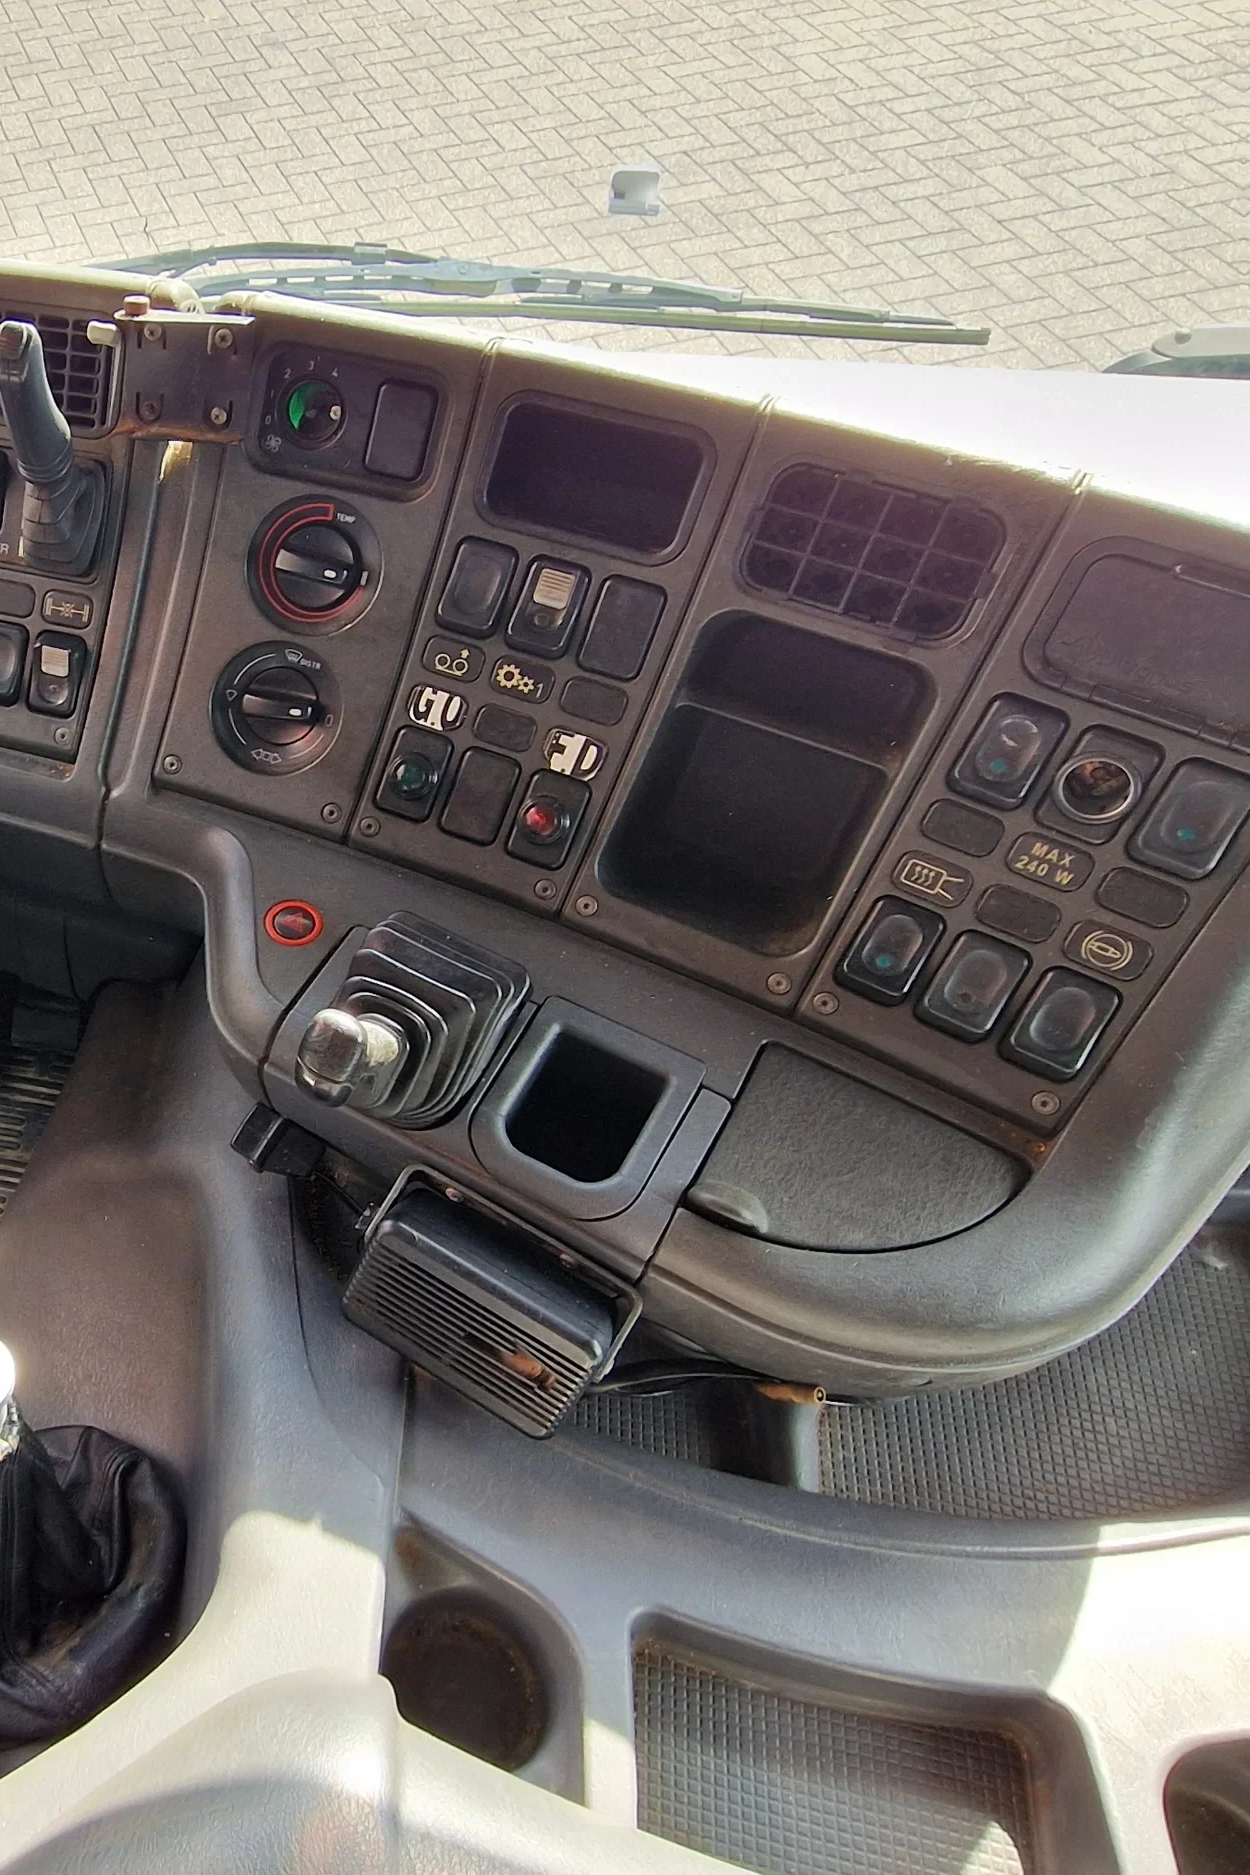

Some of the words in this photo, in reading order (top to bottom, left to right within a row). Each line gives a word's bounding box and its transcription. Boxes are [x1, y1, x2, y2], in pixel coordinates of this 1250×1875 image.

[535, 682, 544, 698] 1
[1031, 842, 1075, 868] MAX
[1014, 855, 1049, 877] 240
[1055, 869, 1075, 885] W
